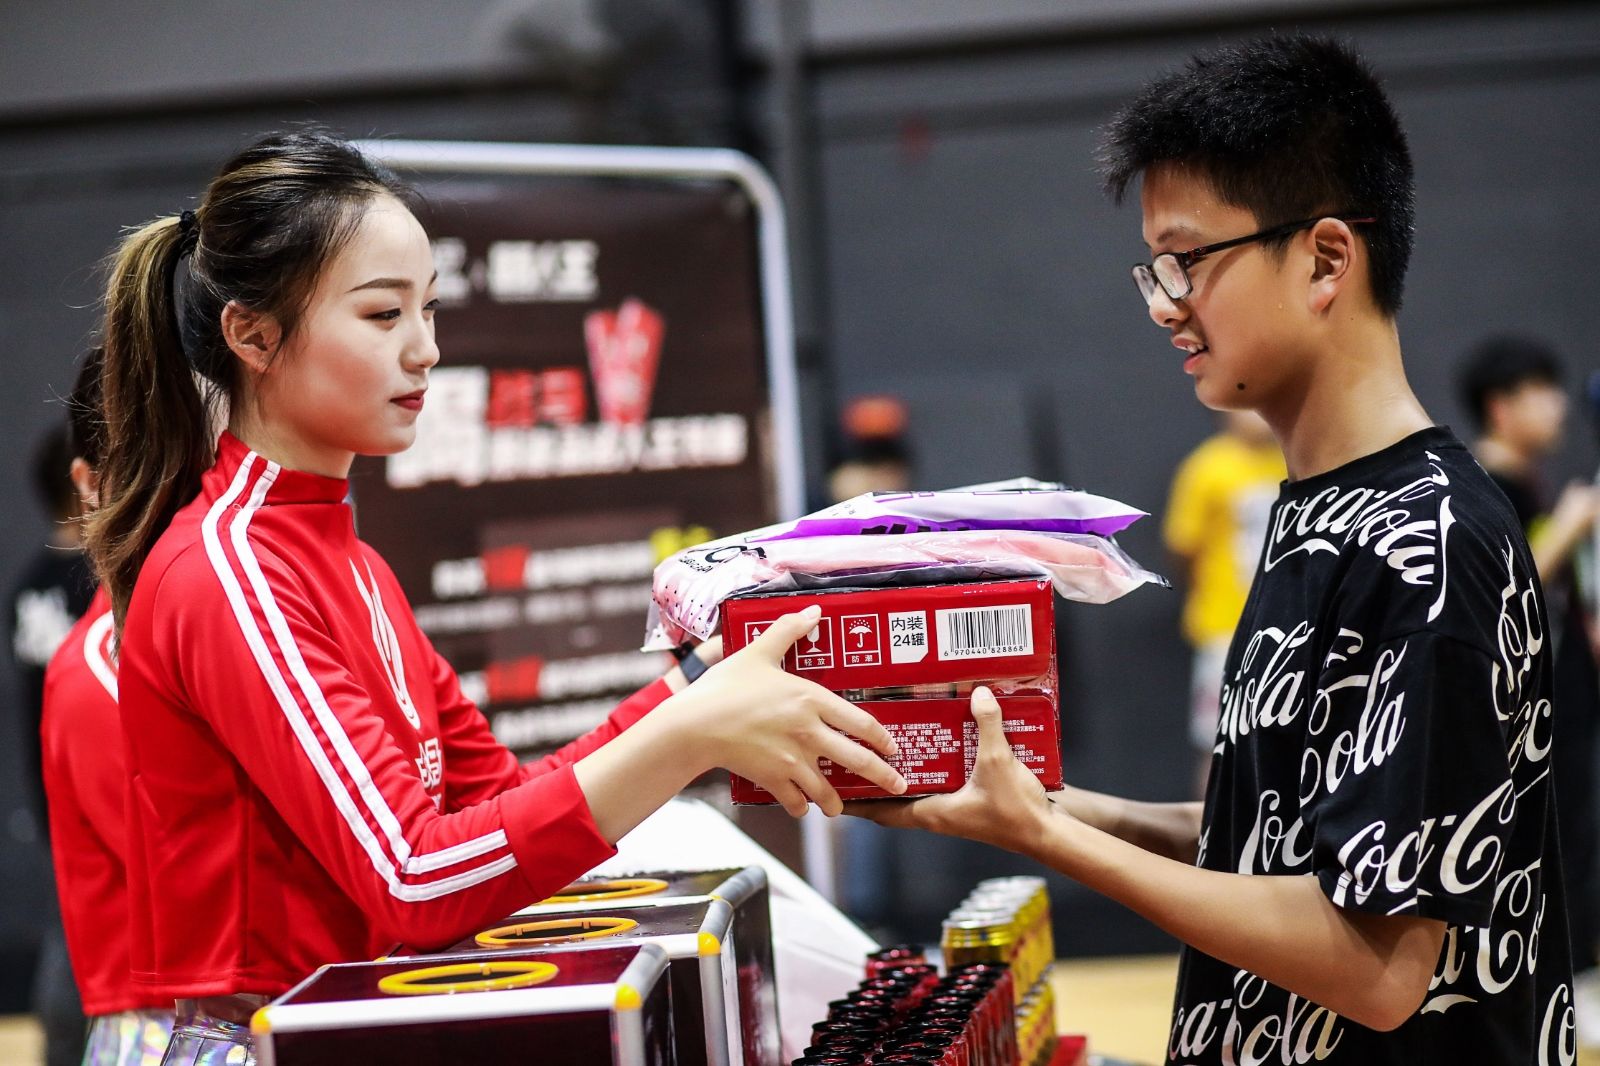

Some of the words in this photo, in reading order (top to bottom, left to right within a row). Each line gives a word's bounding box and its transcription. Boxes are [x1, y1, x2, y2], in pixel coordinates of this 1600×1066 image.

[891, 616, 924, 632] 内装
[892, 632, 926, 649] 24罐
[943, 650, 949, 658] 6
[954, 647, 988, 656] 970440
[991, 645, 1024, 654] 828868
